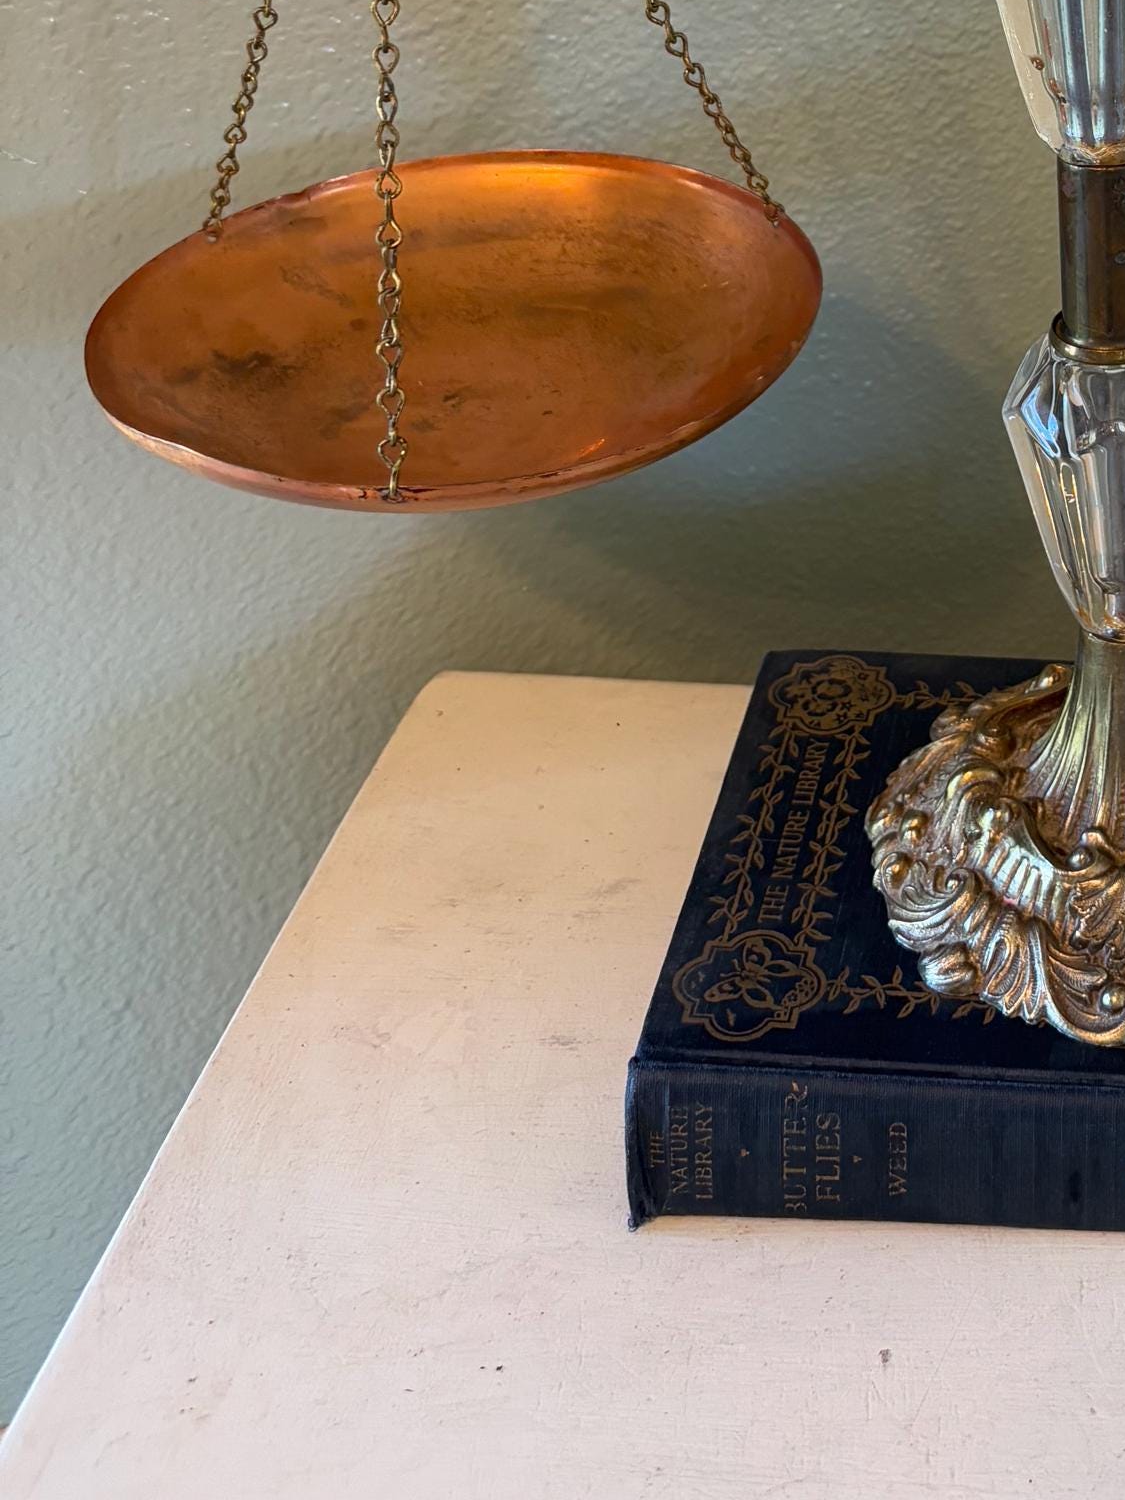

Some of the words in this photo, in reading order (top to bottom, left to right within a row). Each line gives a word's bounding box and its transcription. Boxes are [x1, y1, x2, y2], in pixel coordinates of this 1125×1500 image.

[791, 738, 830, 806] LIBRARY
[771, 808, 810, 880] NATURE
[757, 884, 789, 924] THE
[650, 1130, 665, 1169] THE
[670, 1105, 689, 1196] NATURE
[694, 1101, 714, 1201] LIBRARY
[815, 1112, 841, 1202] FLIES
[889, 1121, 908, 1197] WEED
